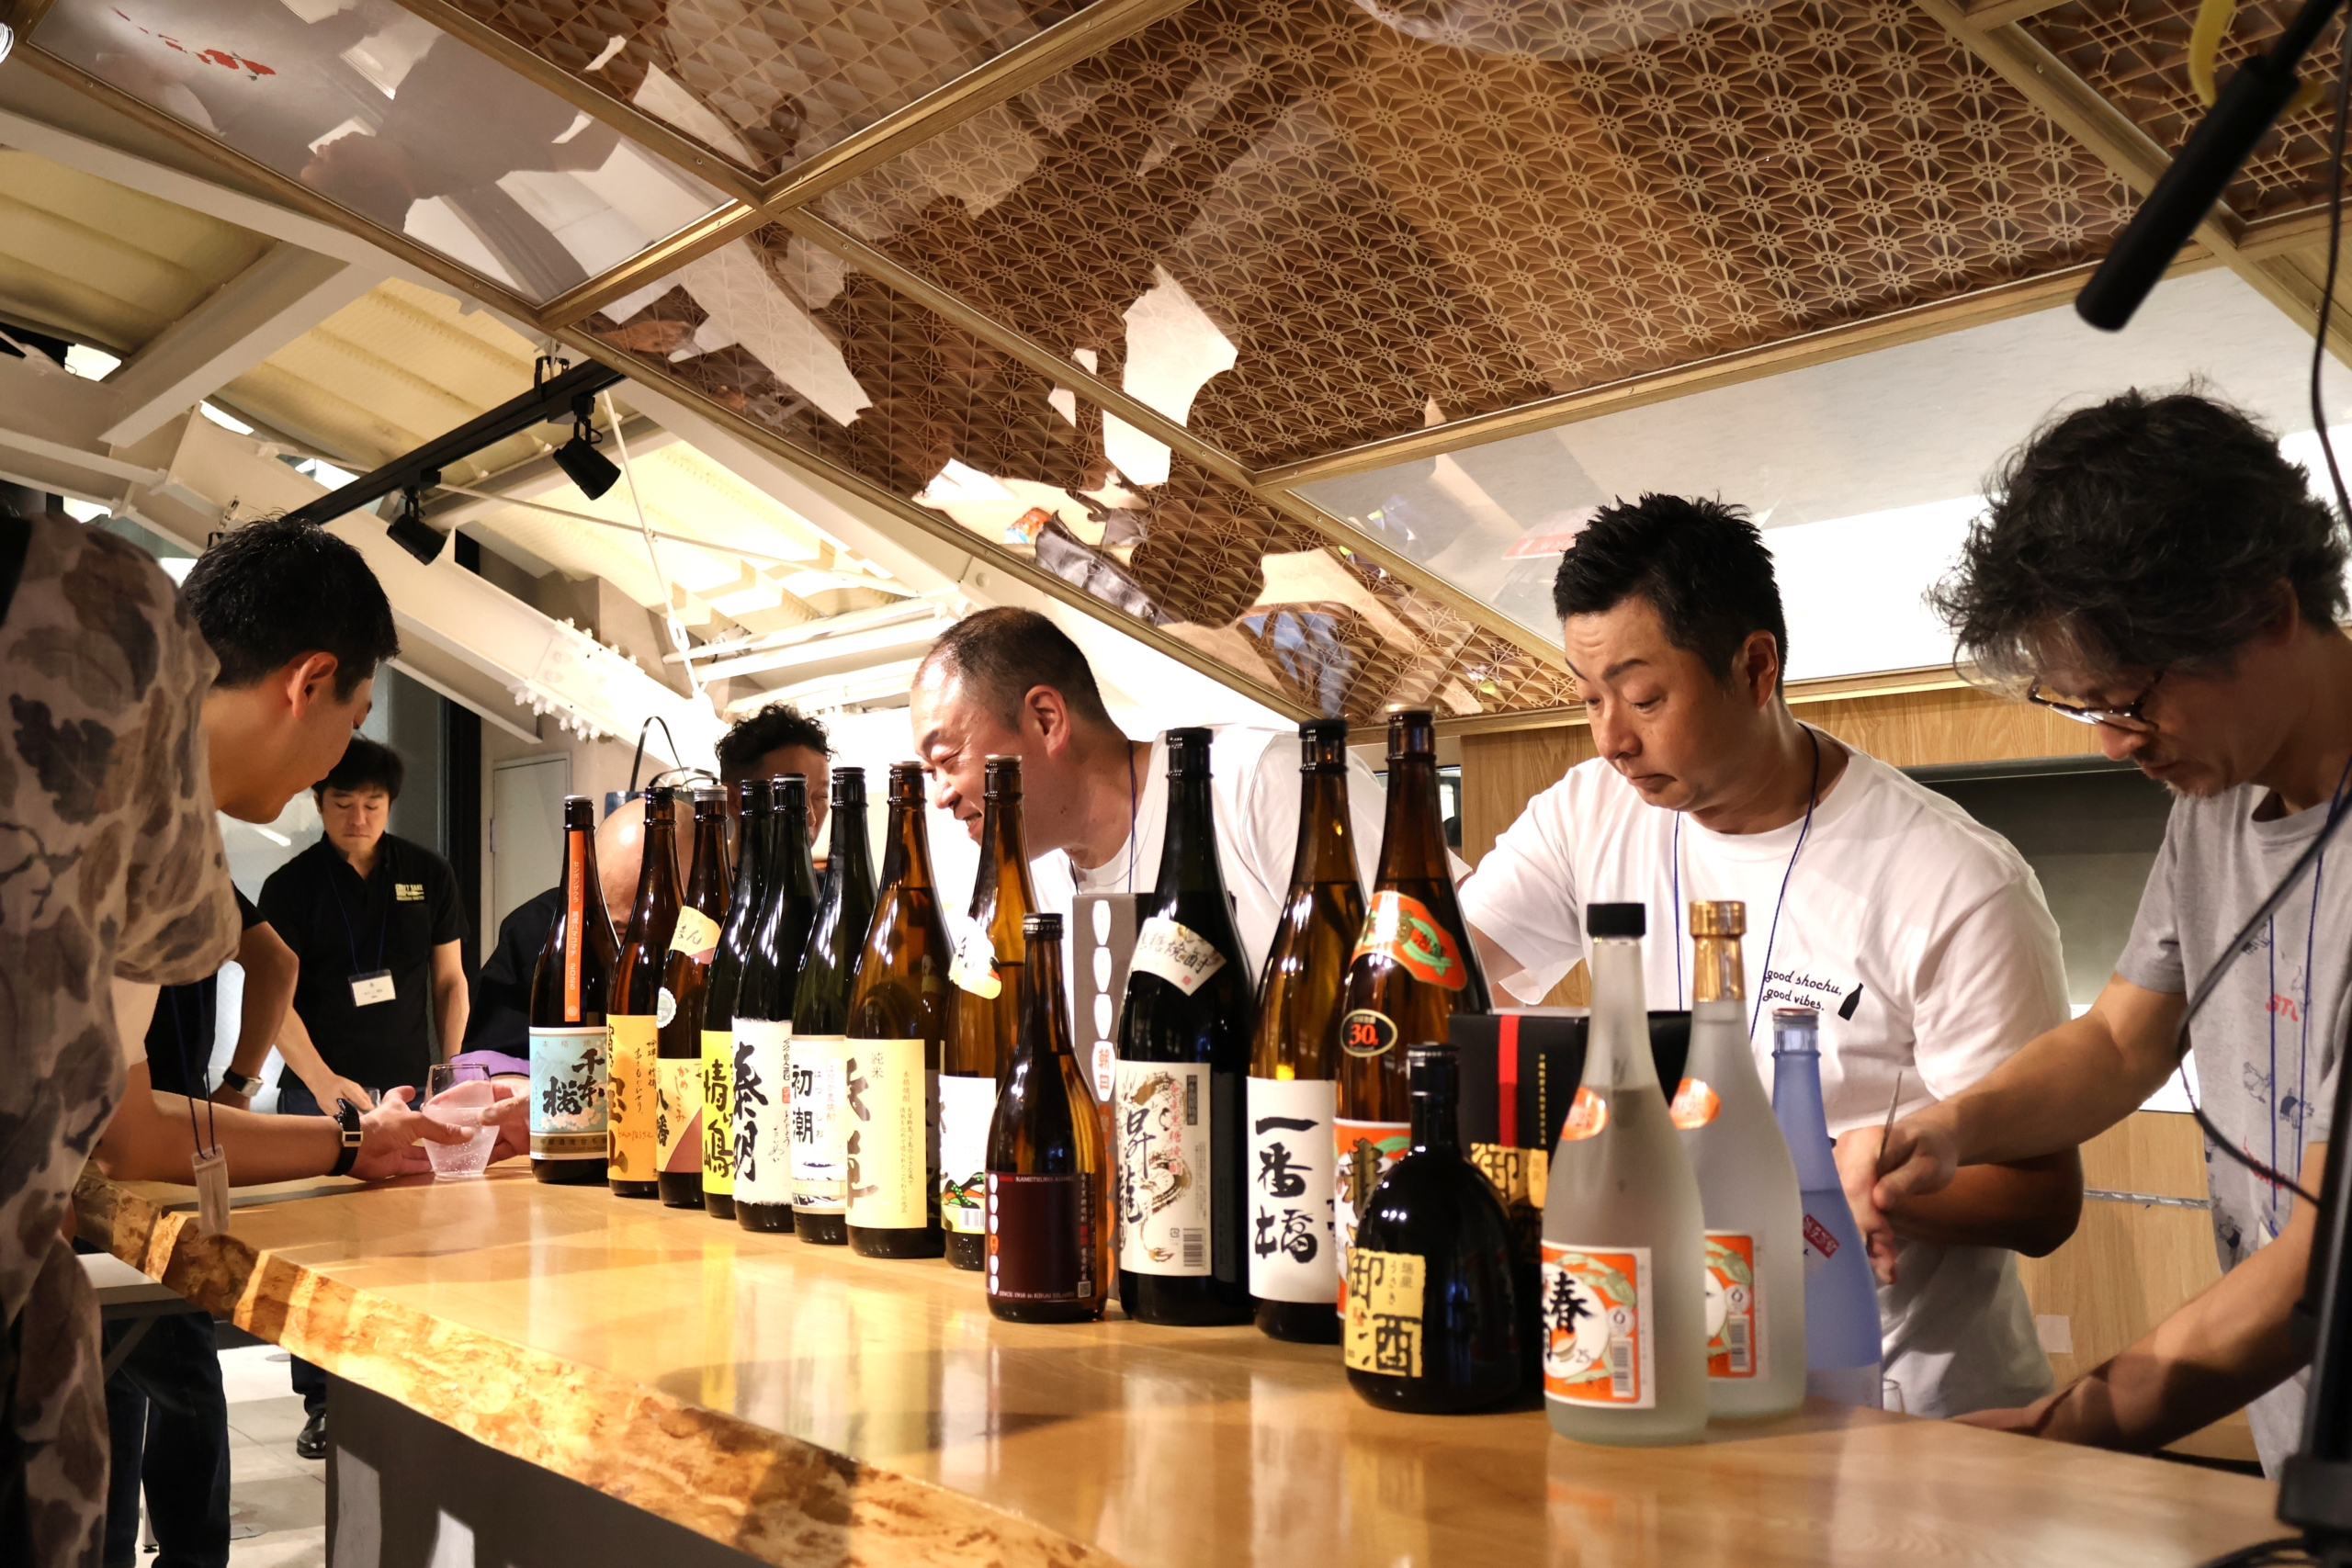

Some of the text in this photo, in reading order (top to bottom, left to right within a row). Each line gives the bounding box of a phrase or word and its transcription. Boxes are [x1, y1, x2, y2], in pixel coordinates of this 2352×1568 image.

[1766, 970, 1842, 997] good shochu,
[1762, 988, 1825, 1011] good vibes.
[1098, 1048, 1111, 1090] 朝日
